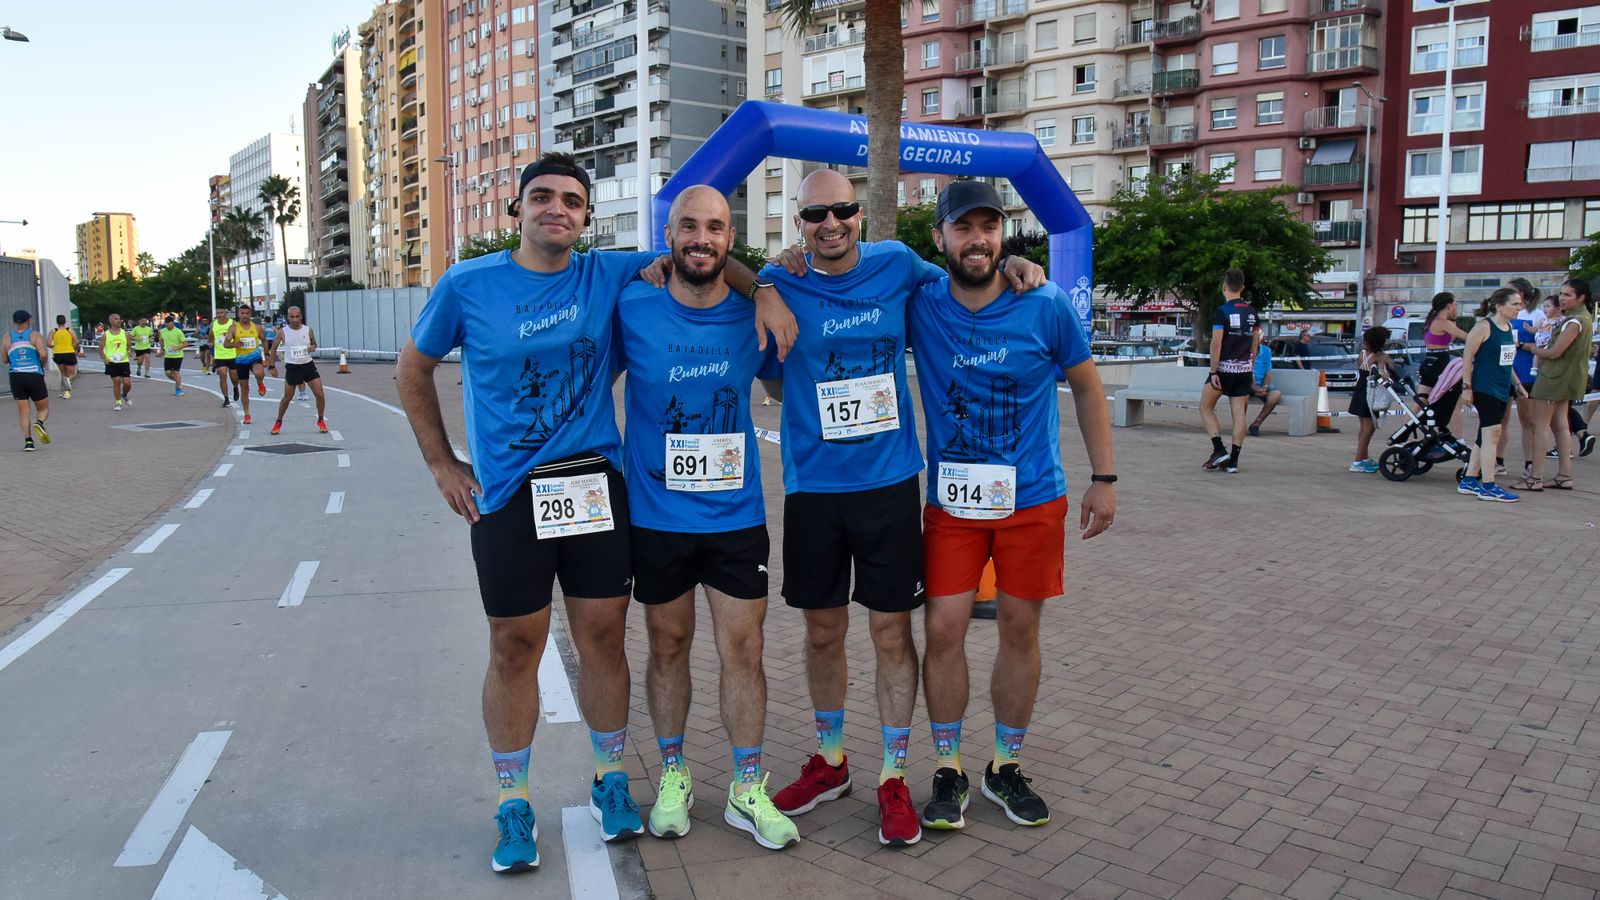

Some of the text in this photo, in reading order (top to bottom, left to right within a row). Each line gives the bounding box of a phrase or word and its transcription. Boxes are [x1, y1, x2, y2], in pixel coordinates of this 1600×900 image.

[850, 119, 980, 145] AYTAMIENTO
[900, 145, 973, 166] GECIRAS
[518, 304, 580, 339] Running
[822, 307, 882, 336] Running
[668, 343, 730, 356] BAJADILLA
[952, 347, 1009, 369] Running
[668, 360, 731, 383] Running
[821, 387, 835, 397] XXI
[826, 400, 861, 422] 157
[670, 440, 685, 448] XXI
[673, 455, 707, 475] 691
[941, 468, 955, 476] XXI
[536, 484, 550, 493] XXI
[947, 483, 982, 504] 914
[540, 498, 575, 522] 298
